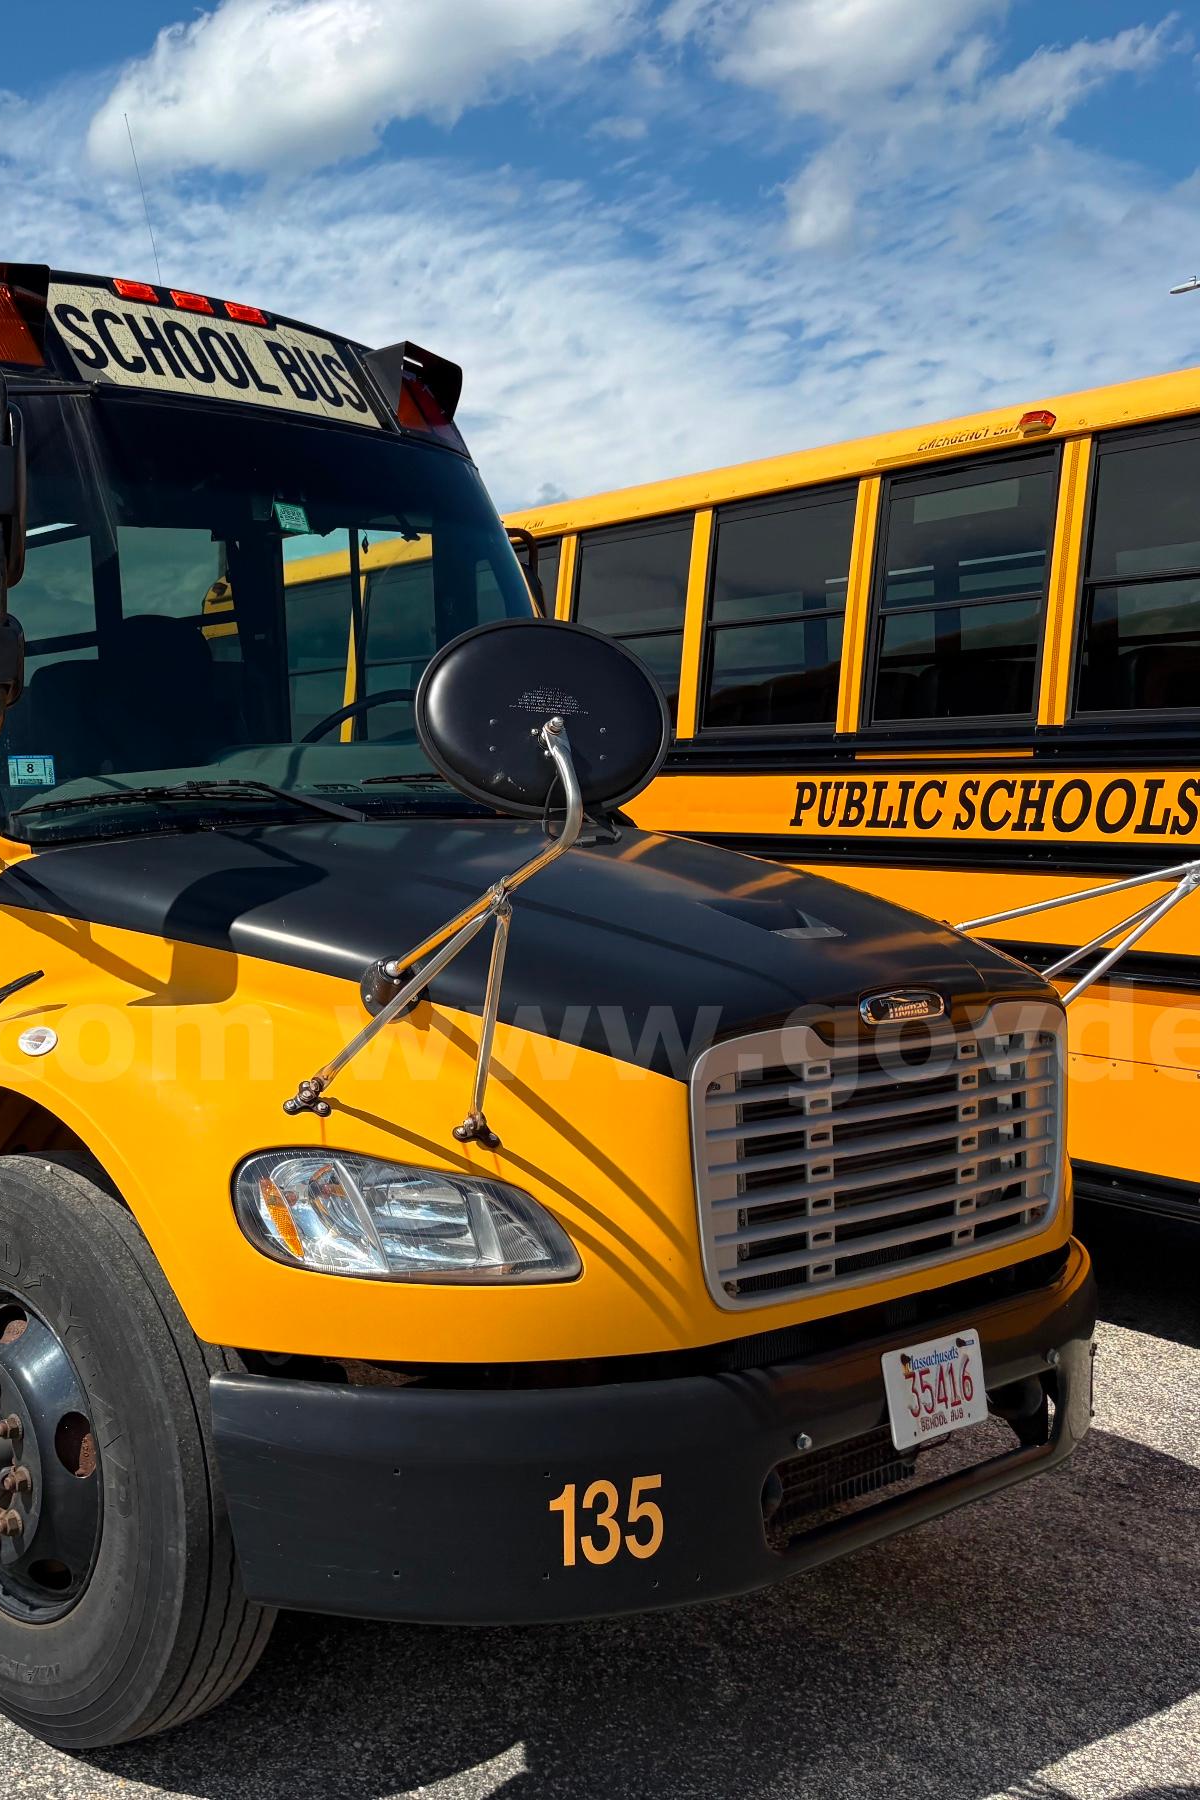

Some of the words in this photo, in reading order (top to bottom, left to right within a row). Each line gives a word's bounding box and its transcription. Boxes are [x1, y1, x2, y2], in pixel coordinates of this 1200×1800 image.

[53, 303, 283, 396] SCHOOL
[264, 339, 369, 414] BUS
[27, 763, 35, 774] 8
[789, 780, 947, 830] PUBLIC
[952, 777, 1200, 836] SCHOOLS
[904, 1354, 974, 1418] 35416
[549, 1473, 665, 1567] 135
